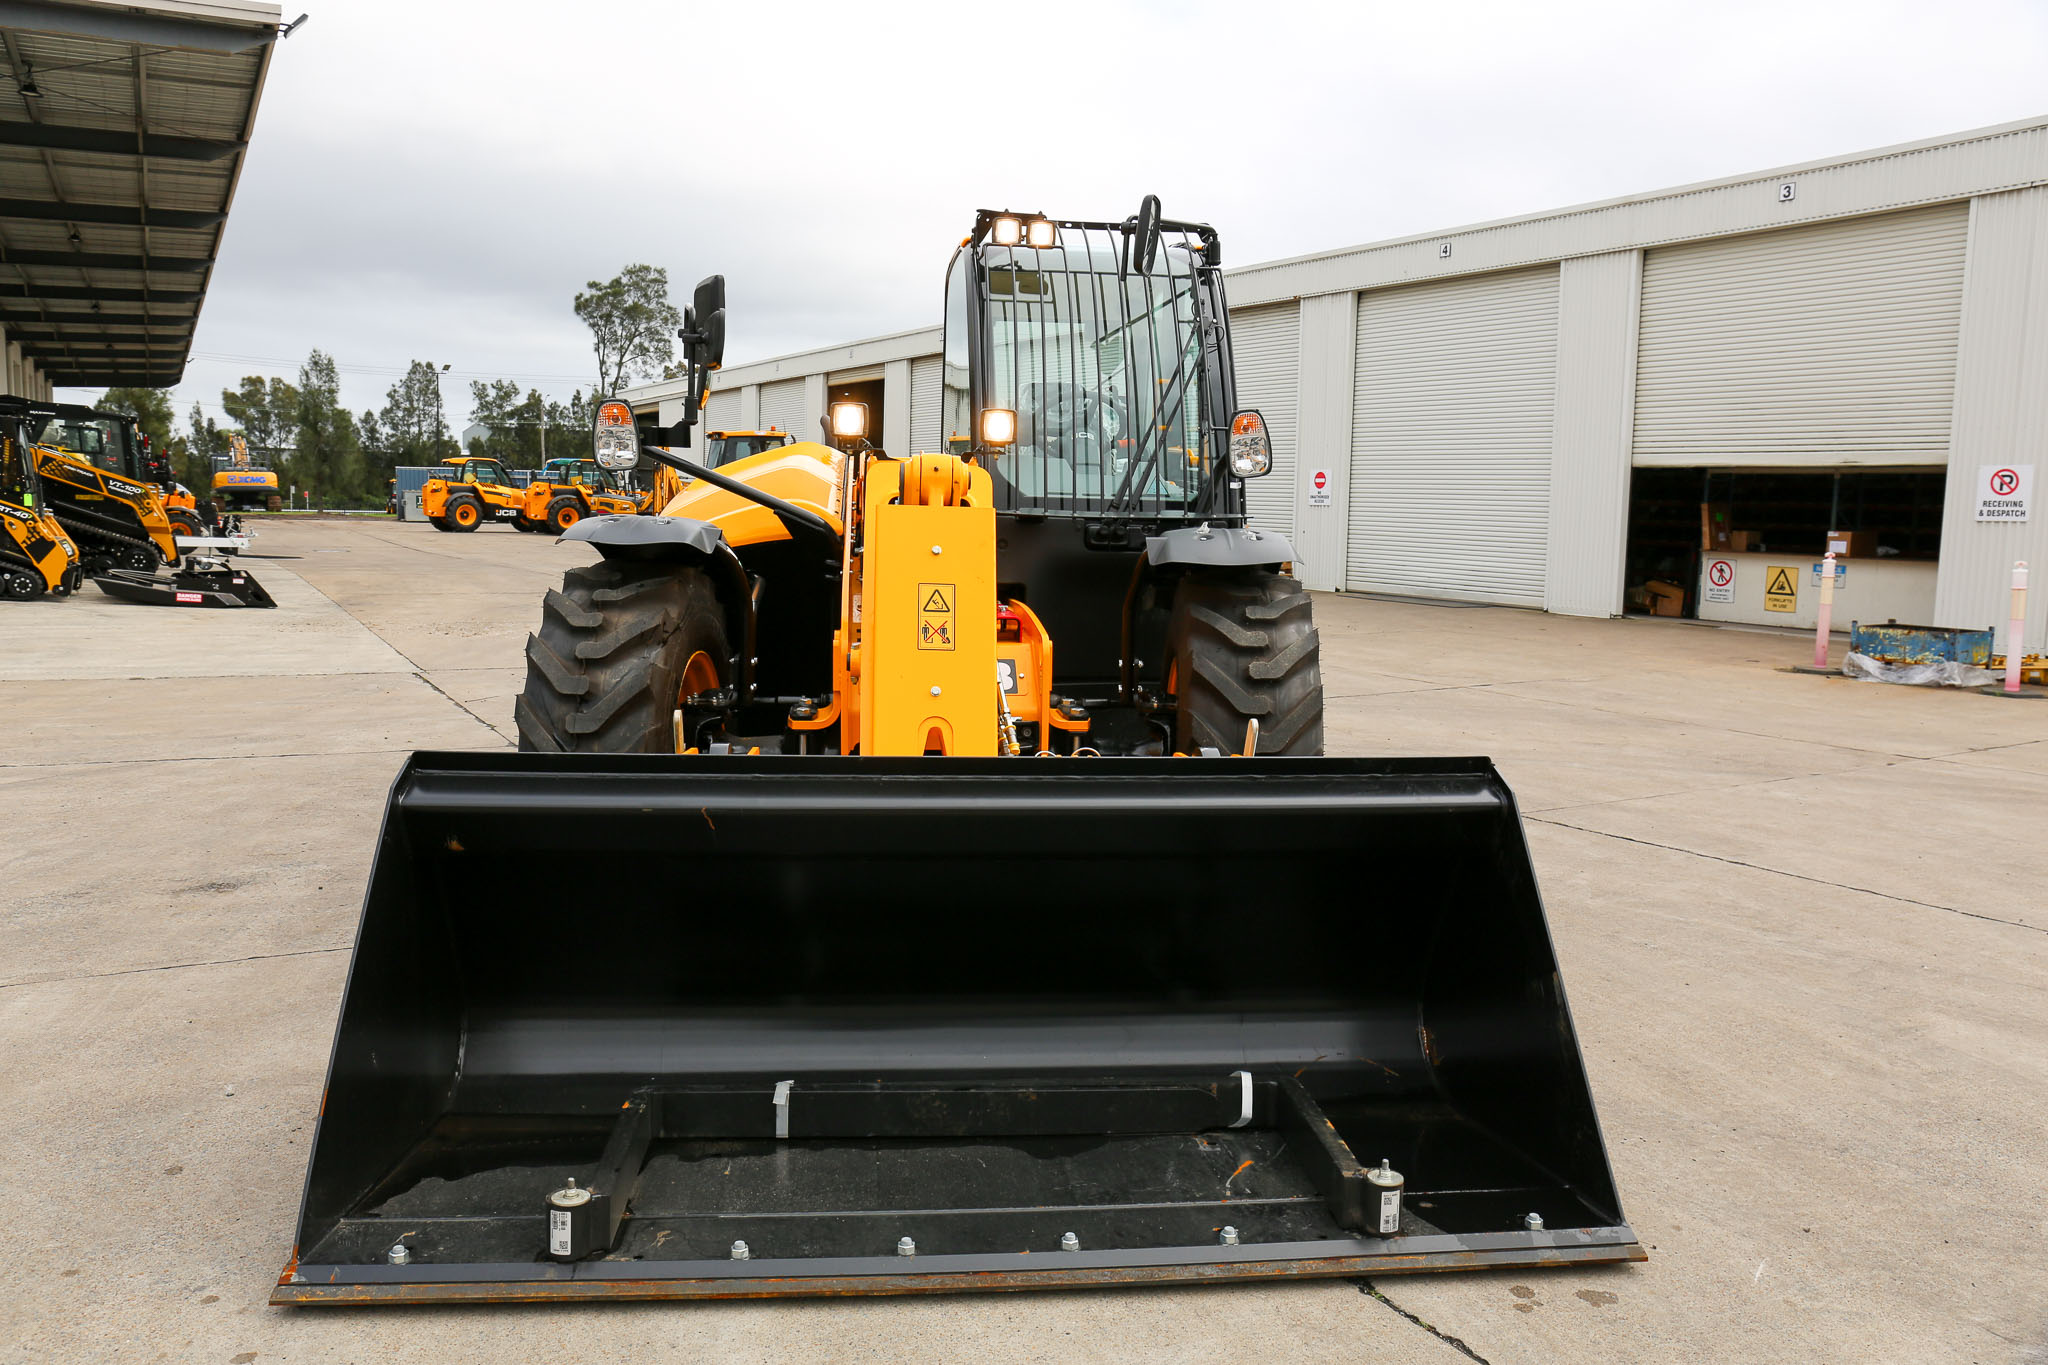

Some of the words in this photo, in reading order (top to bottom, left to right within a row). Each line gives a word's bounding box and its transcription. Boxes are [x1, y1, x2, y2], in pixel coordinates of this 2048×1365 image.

[1783, 185, 1791, 198] 3
[1442, 245, 1448, 255] 4
[109, 480, 142, 494] VT-100
[1982, 500, 2024, 508] RECEIVING
[495, 509, 517, 517] JCB
[1986, 510, 2026, 518] DESPATCH
